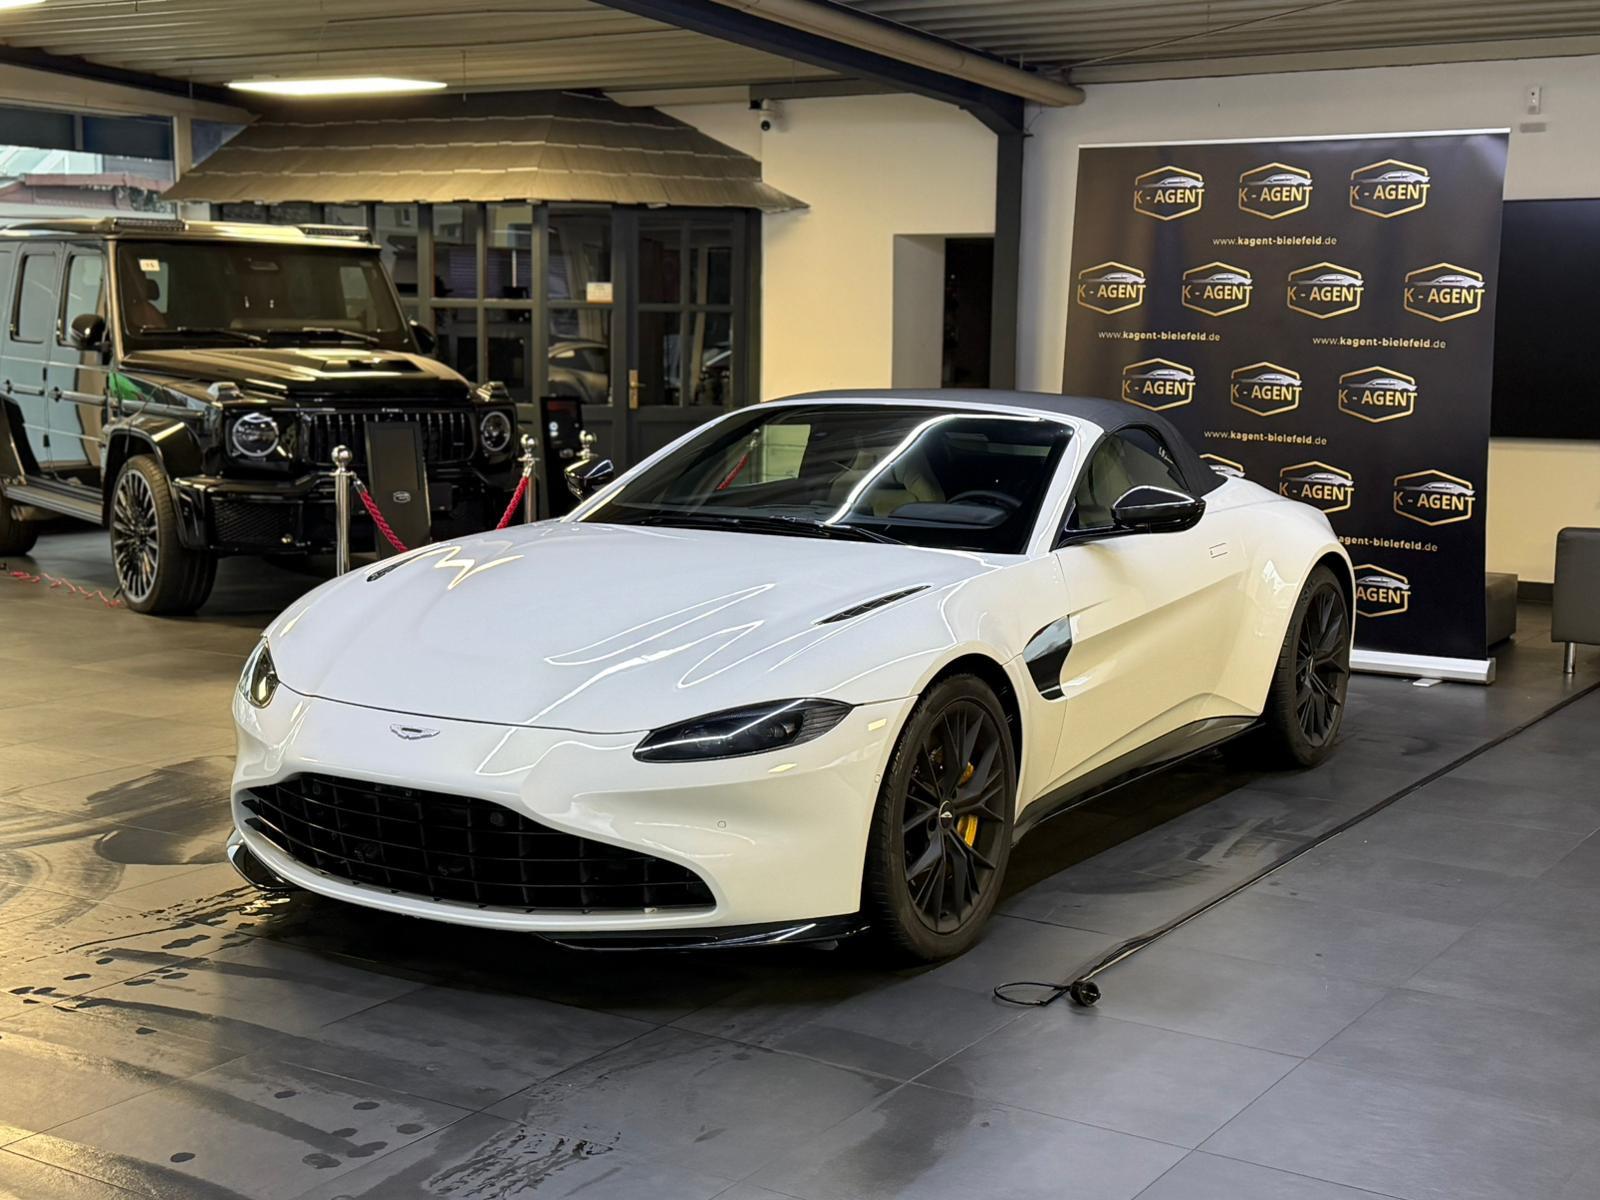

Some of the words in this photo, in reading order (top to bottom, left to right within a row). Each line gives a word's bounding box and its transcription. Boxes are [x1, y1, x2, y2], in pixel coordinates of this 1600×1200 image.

[1134, 191, 1143, 204] K
[1154, 189, 1205, 203] AGENT
[1239, 188, 1248, 201] K
[1260, 186, 1313, 201] AGENT
[1350, 186, 1360, 199] K
[1373, 184, 1431, 199] AGENT
[1212, 235, 1337, 247] www.kagent-bielefeld.de
[1077, 284, 1086, 298] K
[1097, 284, 1146, 298] AGENT
[1182, 285, 1191, 298] K
[1203, 285, 1253, 300] AGENT
[1287, 287, 1297, 300] K
[1309, 287, 1364, 302] AGENT
[1404, 288, 1414, 303] K
[1427, 288, 1485, 304] AGENT
[1098, 330, 1221, 342] www.kagent-bielefeld.de
[1312, 336, 1446, 349] www.kagent-bielefeld.de
[1122, 380, 1131, 393] K
[1143, 381, 1196, 396] AGENT
[1231, 384, 1240, 398] K
[1251, 385, 1302, 401] AGENT
[1338, 389, 1348, 403] K
[1361, 390, 1418, 407] AGENT
[1204, 429, 1328, 445] www.kagent-bielefeld.de
[1279, 481, 1288, 496] K
[1301, 484, 1355, 501] AGENT
[1393, 491, 1403, 506] K
[1417, 493, 1476, 511] AGENT
[1338, 535, 1438, 552] agent-bielefeld.de
[1356, 586, 1411, 604] AGENT
